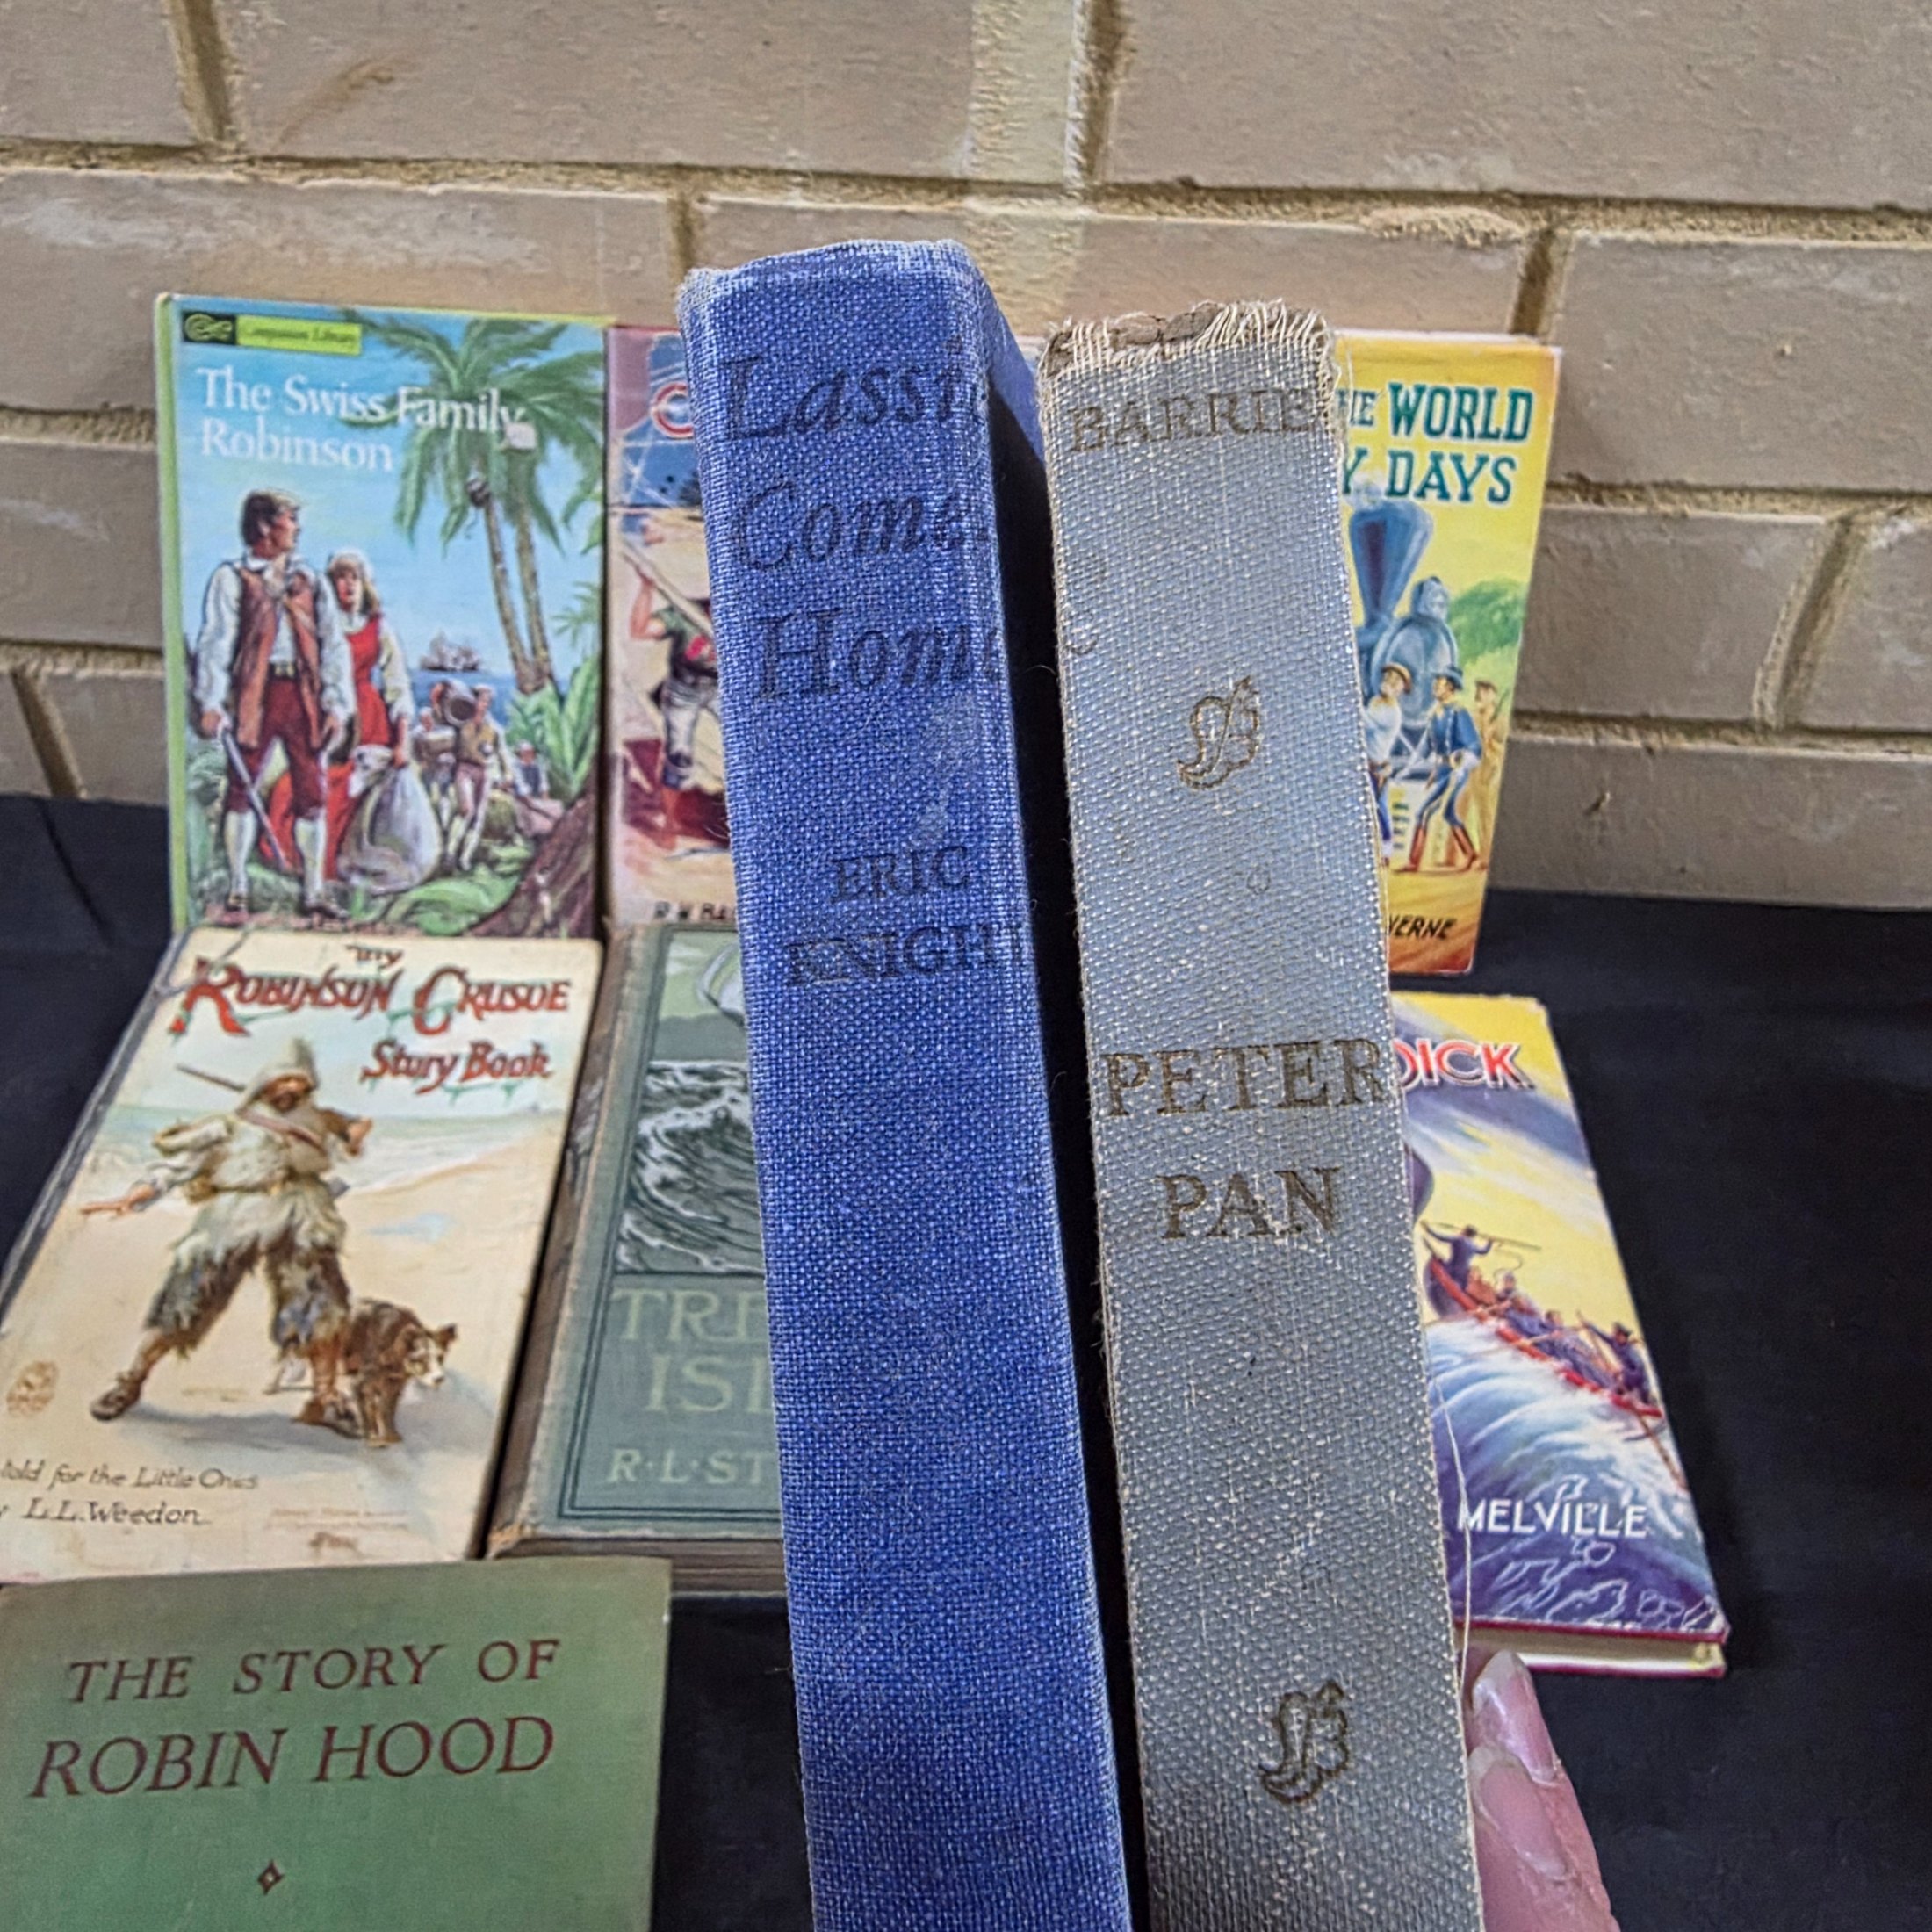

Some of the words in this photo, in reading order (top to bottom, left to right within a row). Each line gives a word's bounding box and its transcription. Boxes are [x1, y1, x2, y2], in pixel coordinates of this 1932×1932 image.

[196, 364, 273, 413] The
[284, 374, 389, 421] Swiss
[396, 385, 527, 433] Family
[1068, 389, 1315, 451] BARRIE
[1388, 382, 1534, 443] WORLD
[201, 415, 393, 472] Robinson
[1385, 448, 1517, 504] DAYS
[831, 844, 970, 904] ERIC
[359, 1034, 457, 1095] Story
[458, 1038, 554, 1085] Book
[1101, 1039, 1385, 1117] PETER
[1156, 1167, 1341, 1239] PAN
[49, 1464, 86, 1490] for
[89, 1464, 127, 1488] the
[134, 1465, 195, 1489] Little
[199, 1467, 259, 1490] Ones
[1458, 1498, 1648, 1538] MELVILLE
[69, 1655, 194, 1704] THE
[232, 1643, 447, 1695] STORY
[477, 1639, 560, 1683] OF
[29, 1728, 288, 1799] ROBIN
[311, 1716, 555, 1784] HOOD
